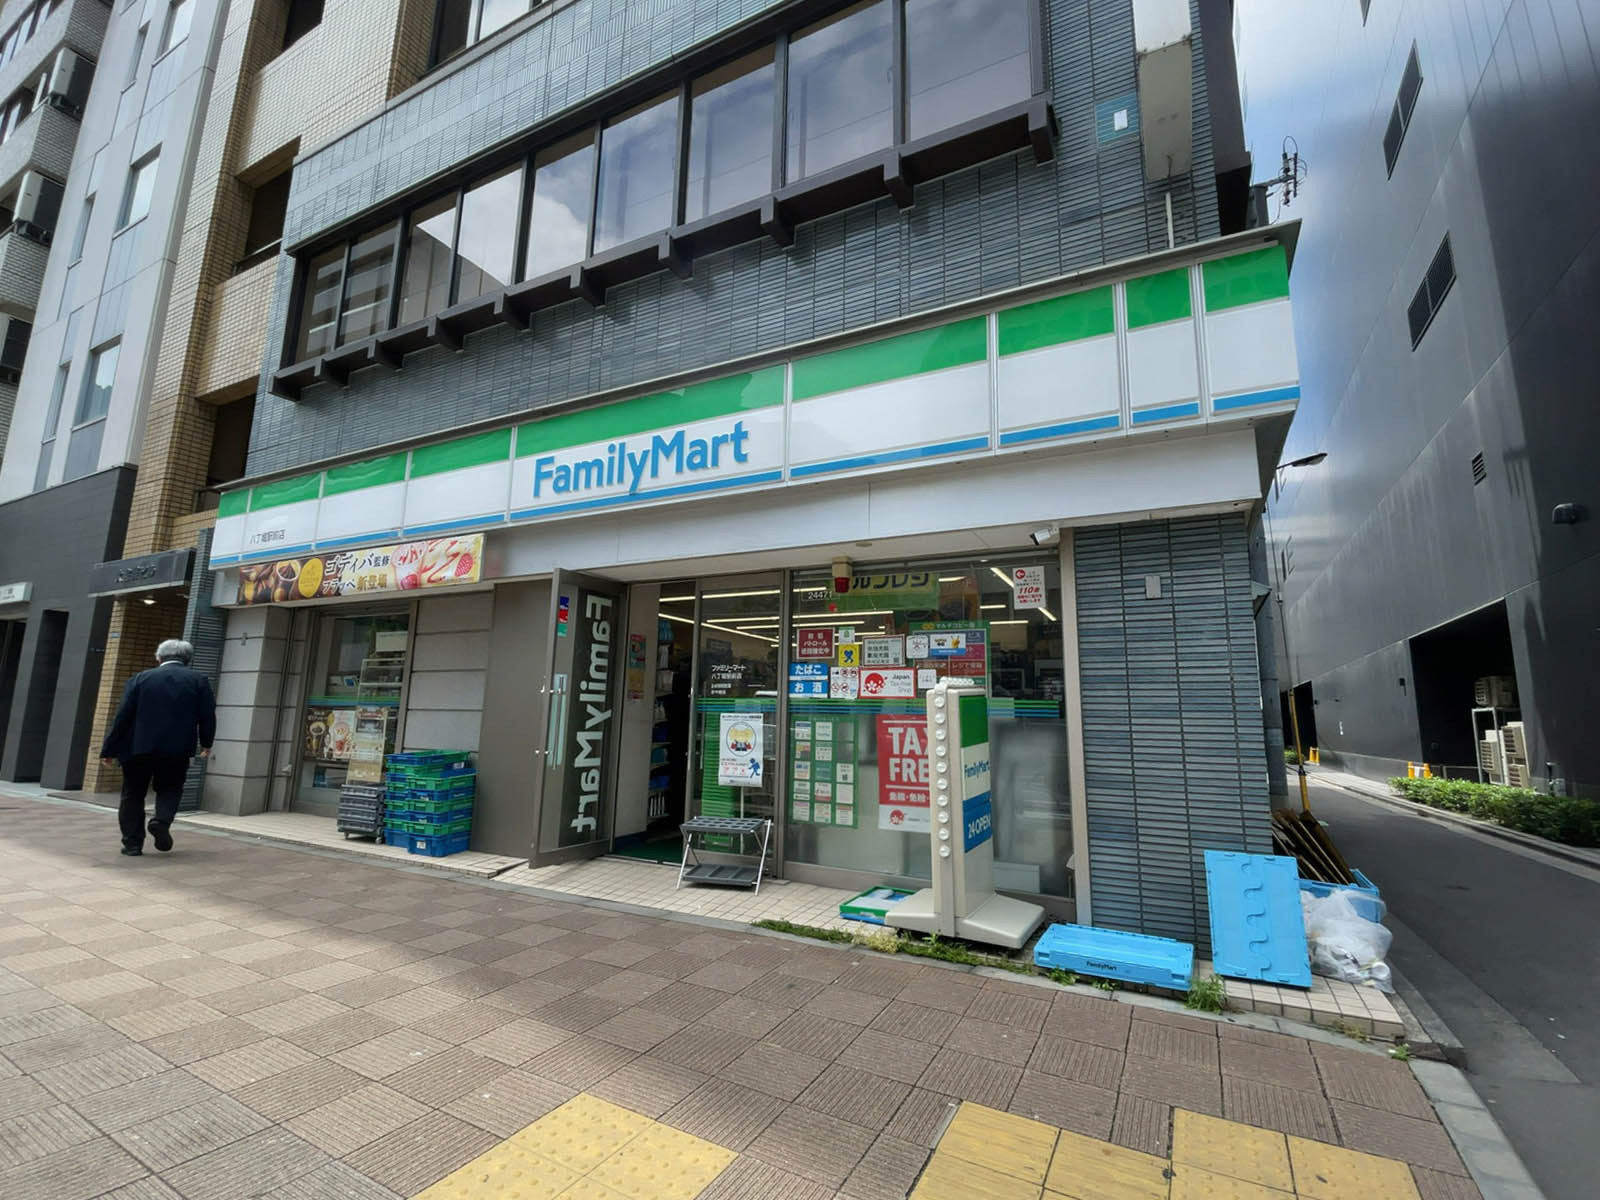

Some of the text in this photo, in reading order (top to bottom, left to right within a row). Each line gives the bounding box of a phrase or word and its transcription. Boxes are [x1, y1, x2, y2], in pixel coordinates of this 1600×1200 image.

[533, 421, 749, 496] FamilyMart
[795, 664, 822, 675] たばこ
[889, 758, 929, 783] FRE
